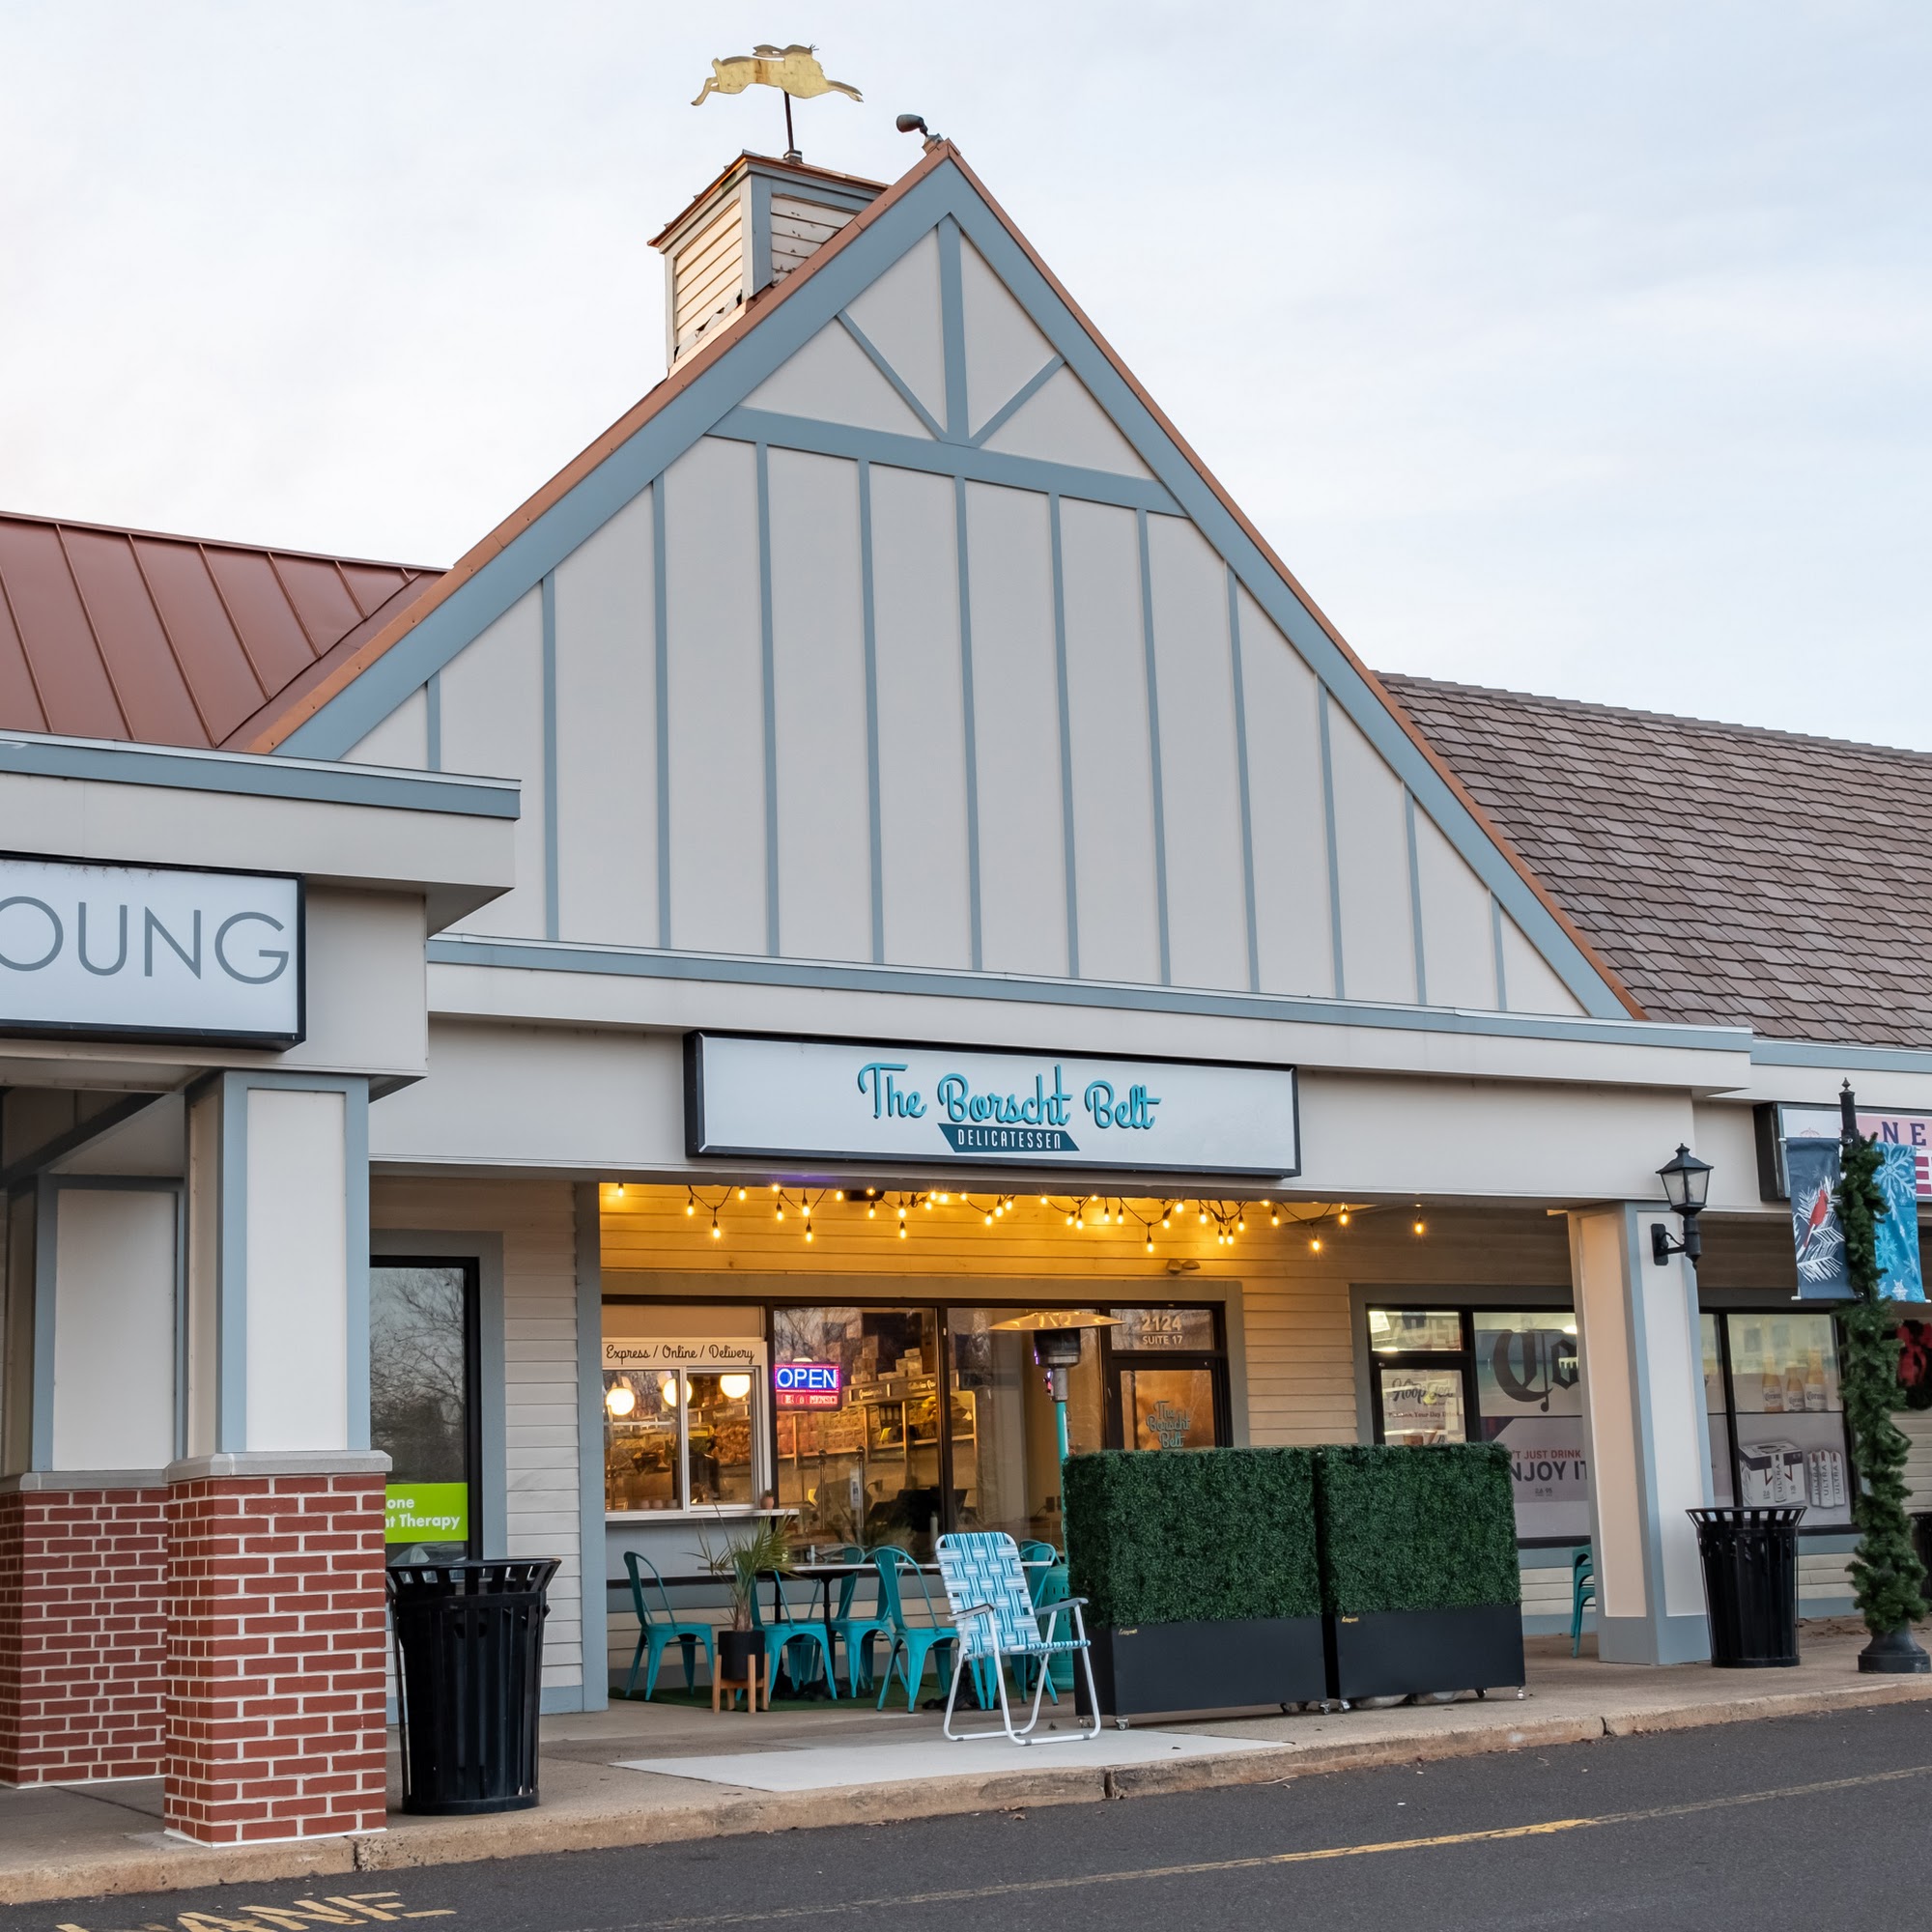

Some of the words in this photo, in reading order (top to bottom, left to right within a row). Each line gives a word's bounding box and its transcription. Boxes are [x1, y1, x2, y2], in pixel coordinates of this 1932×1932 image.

[0, 895, 290, 984] OUNG
[857, 1062, 927, 1119] The
[937, 1064, 1074, 1127] Borscht
[1084, 1079, 1162, 1130] Belt
[957, 1128, 1062, 1151] DELICATESSEN
[1141, 1315, 1182, 1331] 2124
[1142, 1335, 1169, 1345] SUITE
[1172, 1335, 1183, 1345] 17
[606, 1344, 651, 1365] Express
[662, 1344, 697, 1359] Online
[708, 1344, 754, 1365] Delivery
[777, 1368, 838, 1389] OPEN
[1523, 1450, 1548, 1460] JUST
[1550, 1449, 1582, 1460] DRINK
[399, 1513, 461, 1530] Therapy
